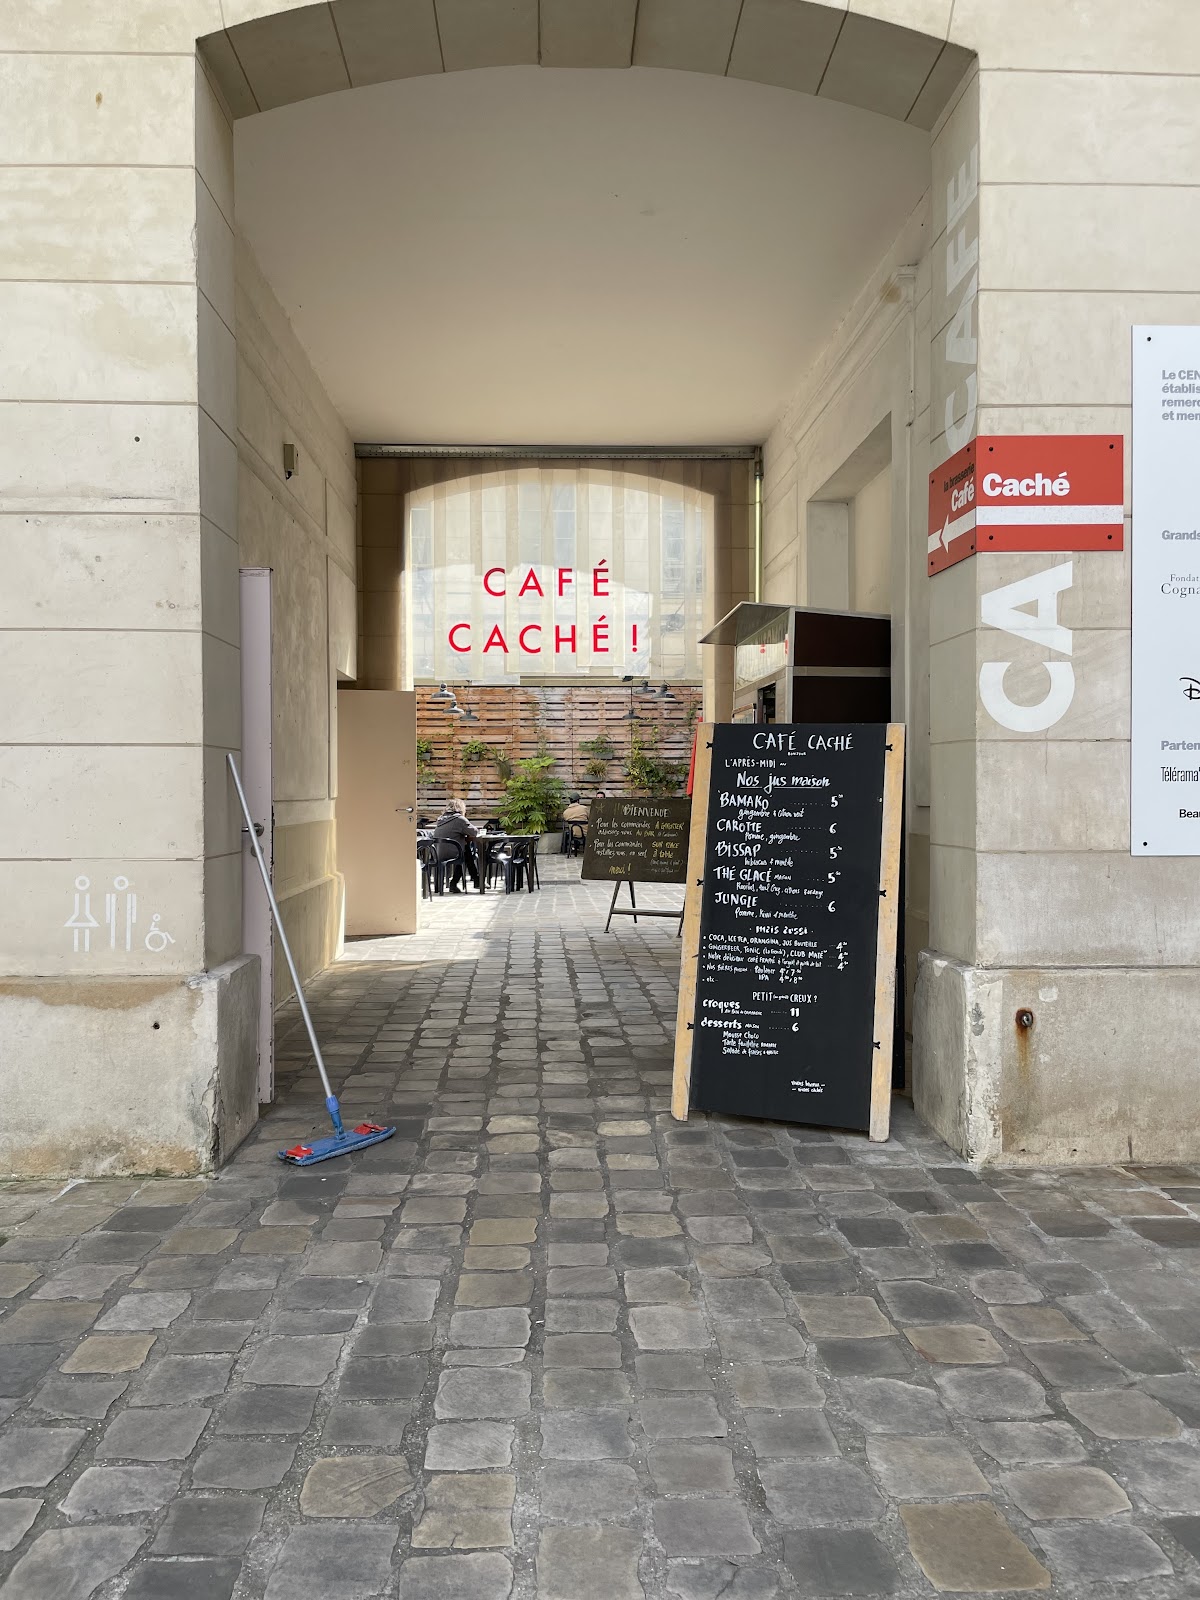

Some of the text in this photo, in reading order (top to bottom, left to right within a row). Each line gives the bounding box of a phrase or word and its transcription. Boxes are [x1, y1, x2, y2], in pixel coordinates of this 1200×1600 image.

[1162, 369, 1176, 380] Le
[1162, 411, 1174, 420] et
[982, 471, 1070, 497] Caché
[951, 476, 975, 512] Café
[483, 558, 610, 598] CAFÉ
[448, 614, 610, 654] CACHÉ
[752, 731, 854, 751] CAFÉ CACHÉ
[736, 771, 831, 794] Nos jus maison
[623, 804, 668, 818] BIENVENUE
[716, 819, 837, 834] CAROTTE 6
[714, 841, 761, 857] BISSAP
[713, 866, 736, 880] THÉ
[739, 868, 772, 882] GLACÉ
[714, 892, 836, 912] JUNGLE 6
[752, 991, 773, 1001] PETIT
[790, 993, 812, 1003] CREUX
[702, 999, 800, 1017] croques 11
[701, 1017, 742, 1029] desserts
[791, 1022, 799, 1032] 6
